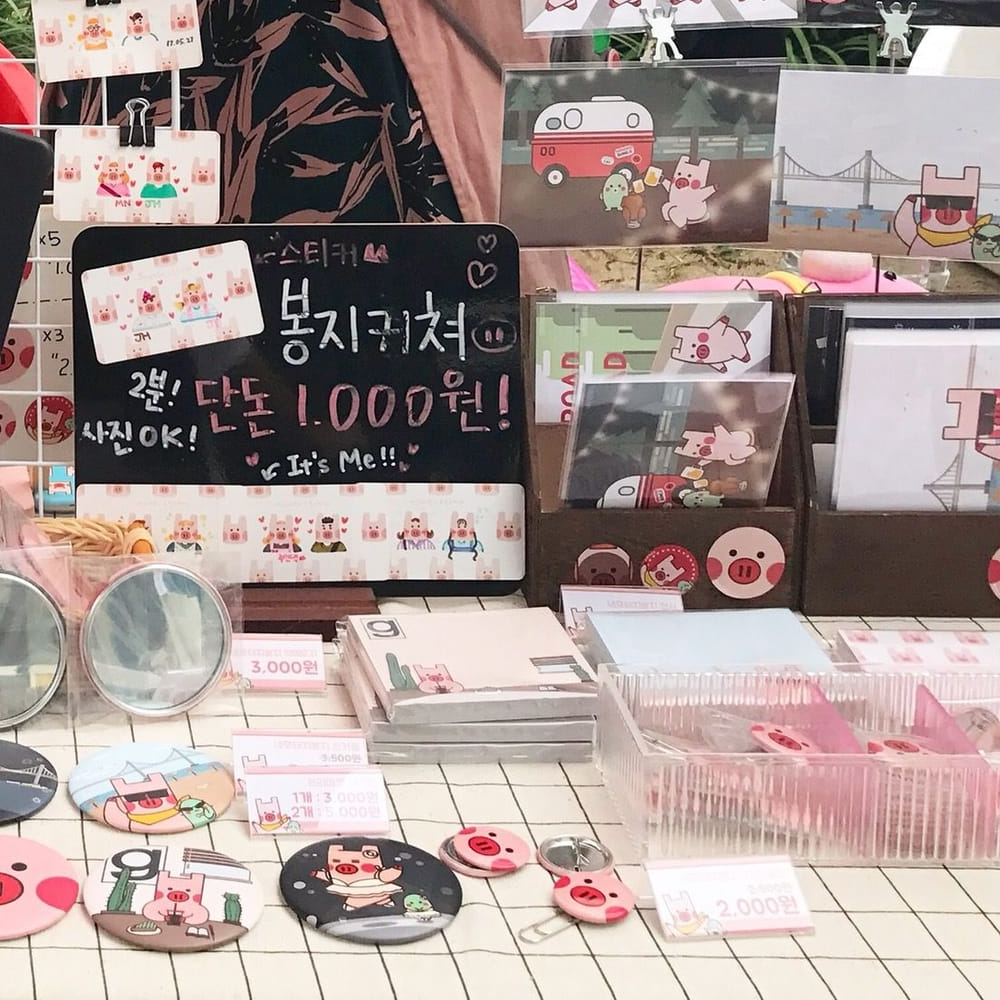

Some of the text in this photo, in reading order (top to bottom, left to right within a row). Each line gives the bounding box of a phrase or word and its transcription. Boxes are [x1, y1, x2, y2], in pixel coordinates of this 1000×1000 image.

[278, 237, 358, 268] 스티커
[128, 367, 182, 412] 2분!
[194, 375, 275, 438] 단돈
[286, 447, 396, 476] It's Me!!
[251, 660, 319, 675] 3,000원
